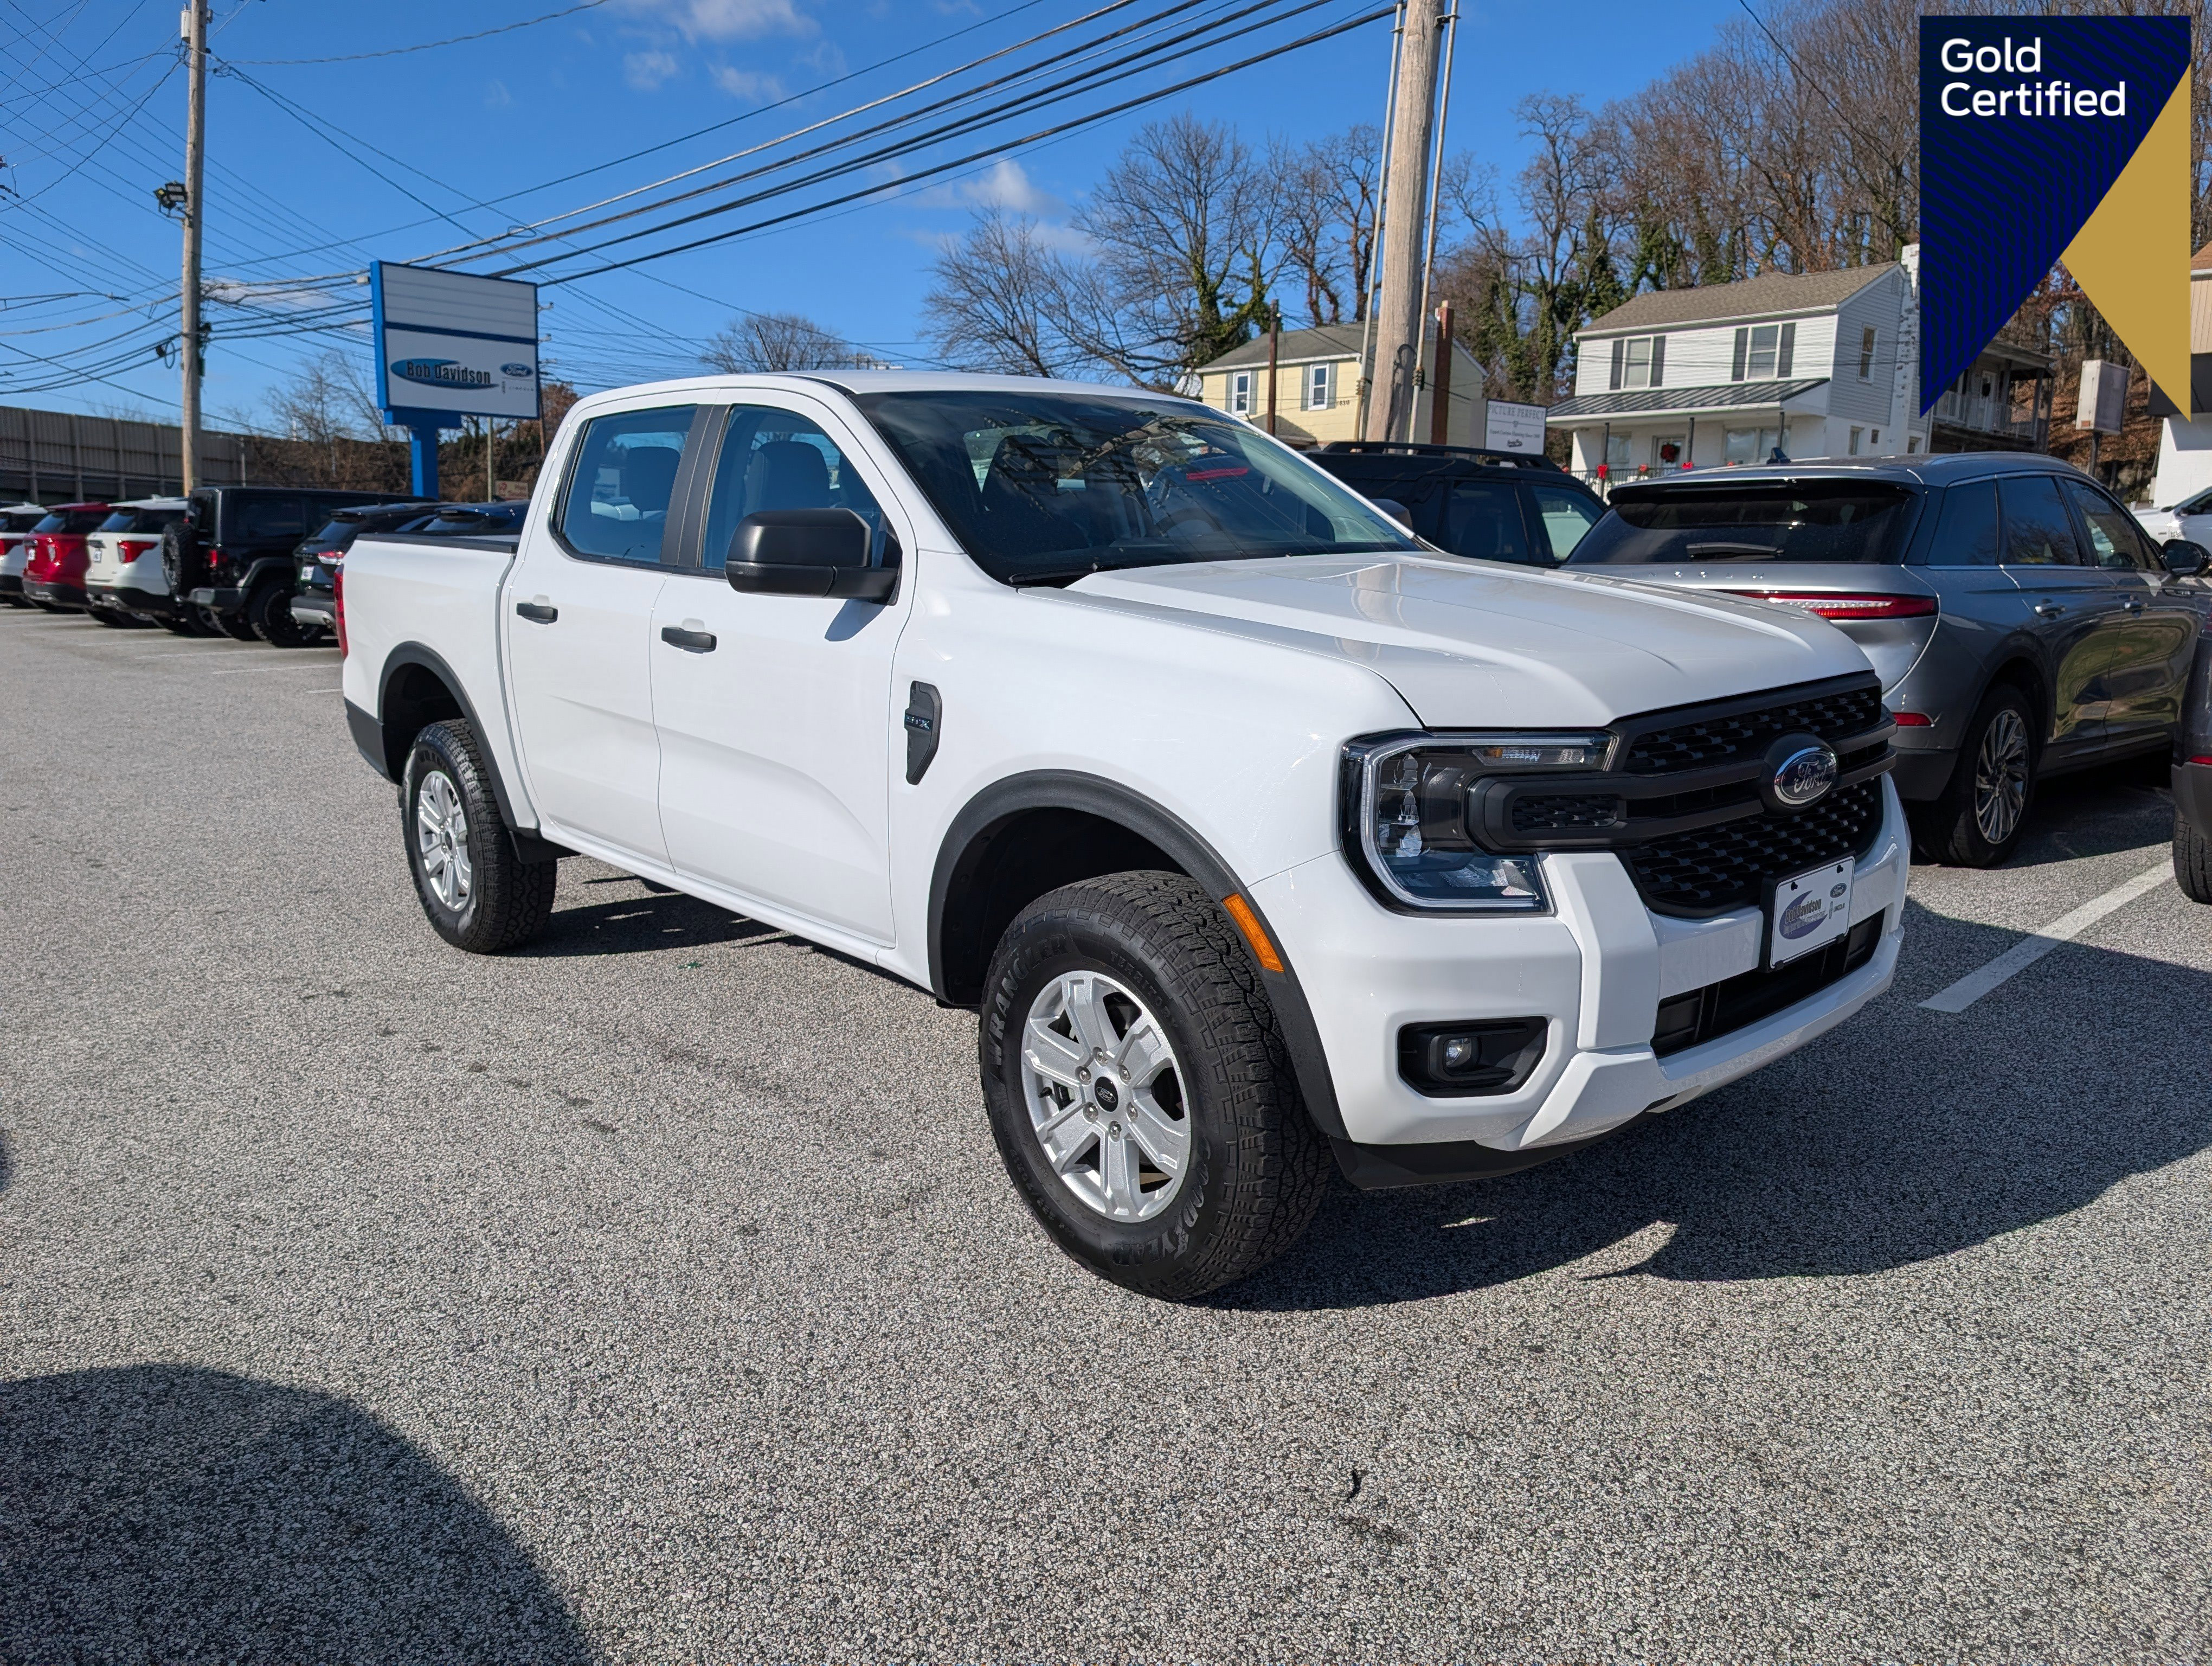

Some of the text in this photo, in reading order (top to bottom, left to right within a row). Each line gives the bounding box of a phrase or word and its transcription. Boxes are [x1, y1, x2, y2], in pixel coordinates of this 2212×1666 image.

[407, 361, 491, 385] Bob Davidson
[1488, 404, 1544, 420] PICTURE PERFECT
[1793, 759, 1828, 793] Ford
[1785, 906, 1797, 924] Bob
[1797, 898, 1822, 919] Davidson
[987, 934, 1070, 1066] WRANGLER
[1110, 950, 1178, 1028] TERRITORY
